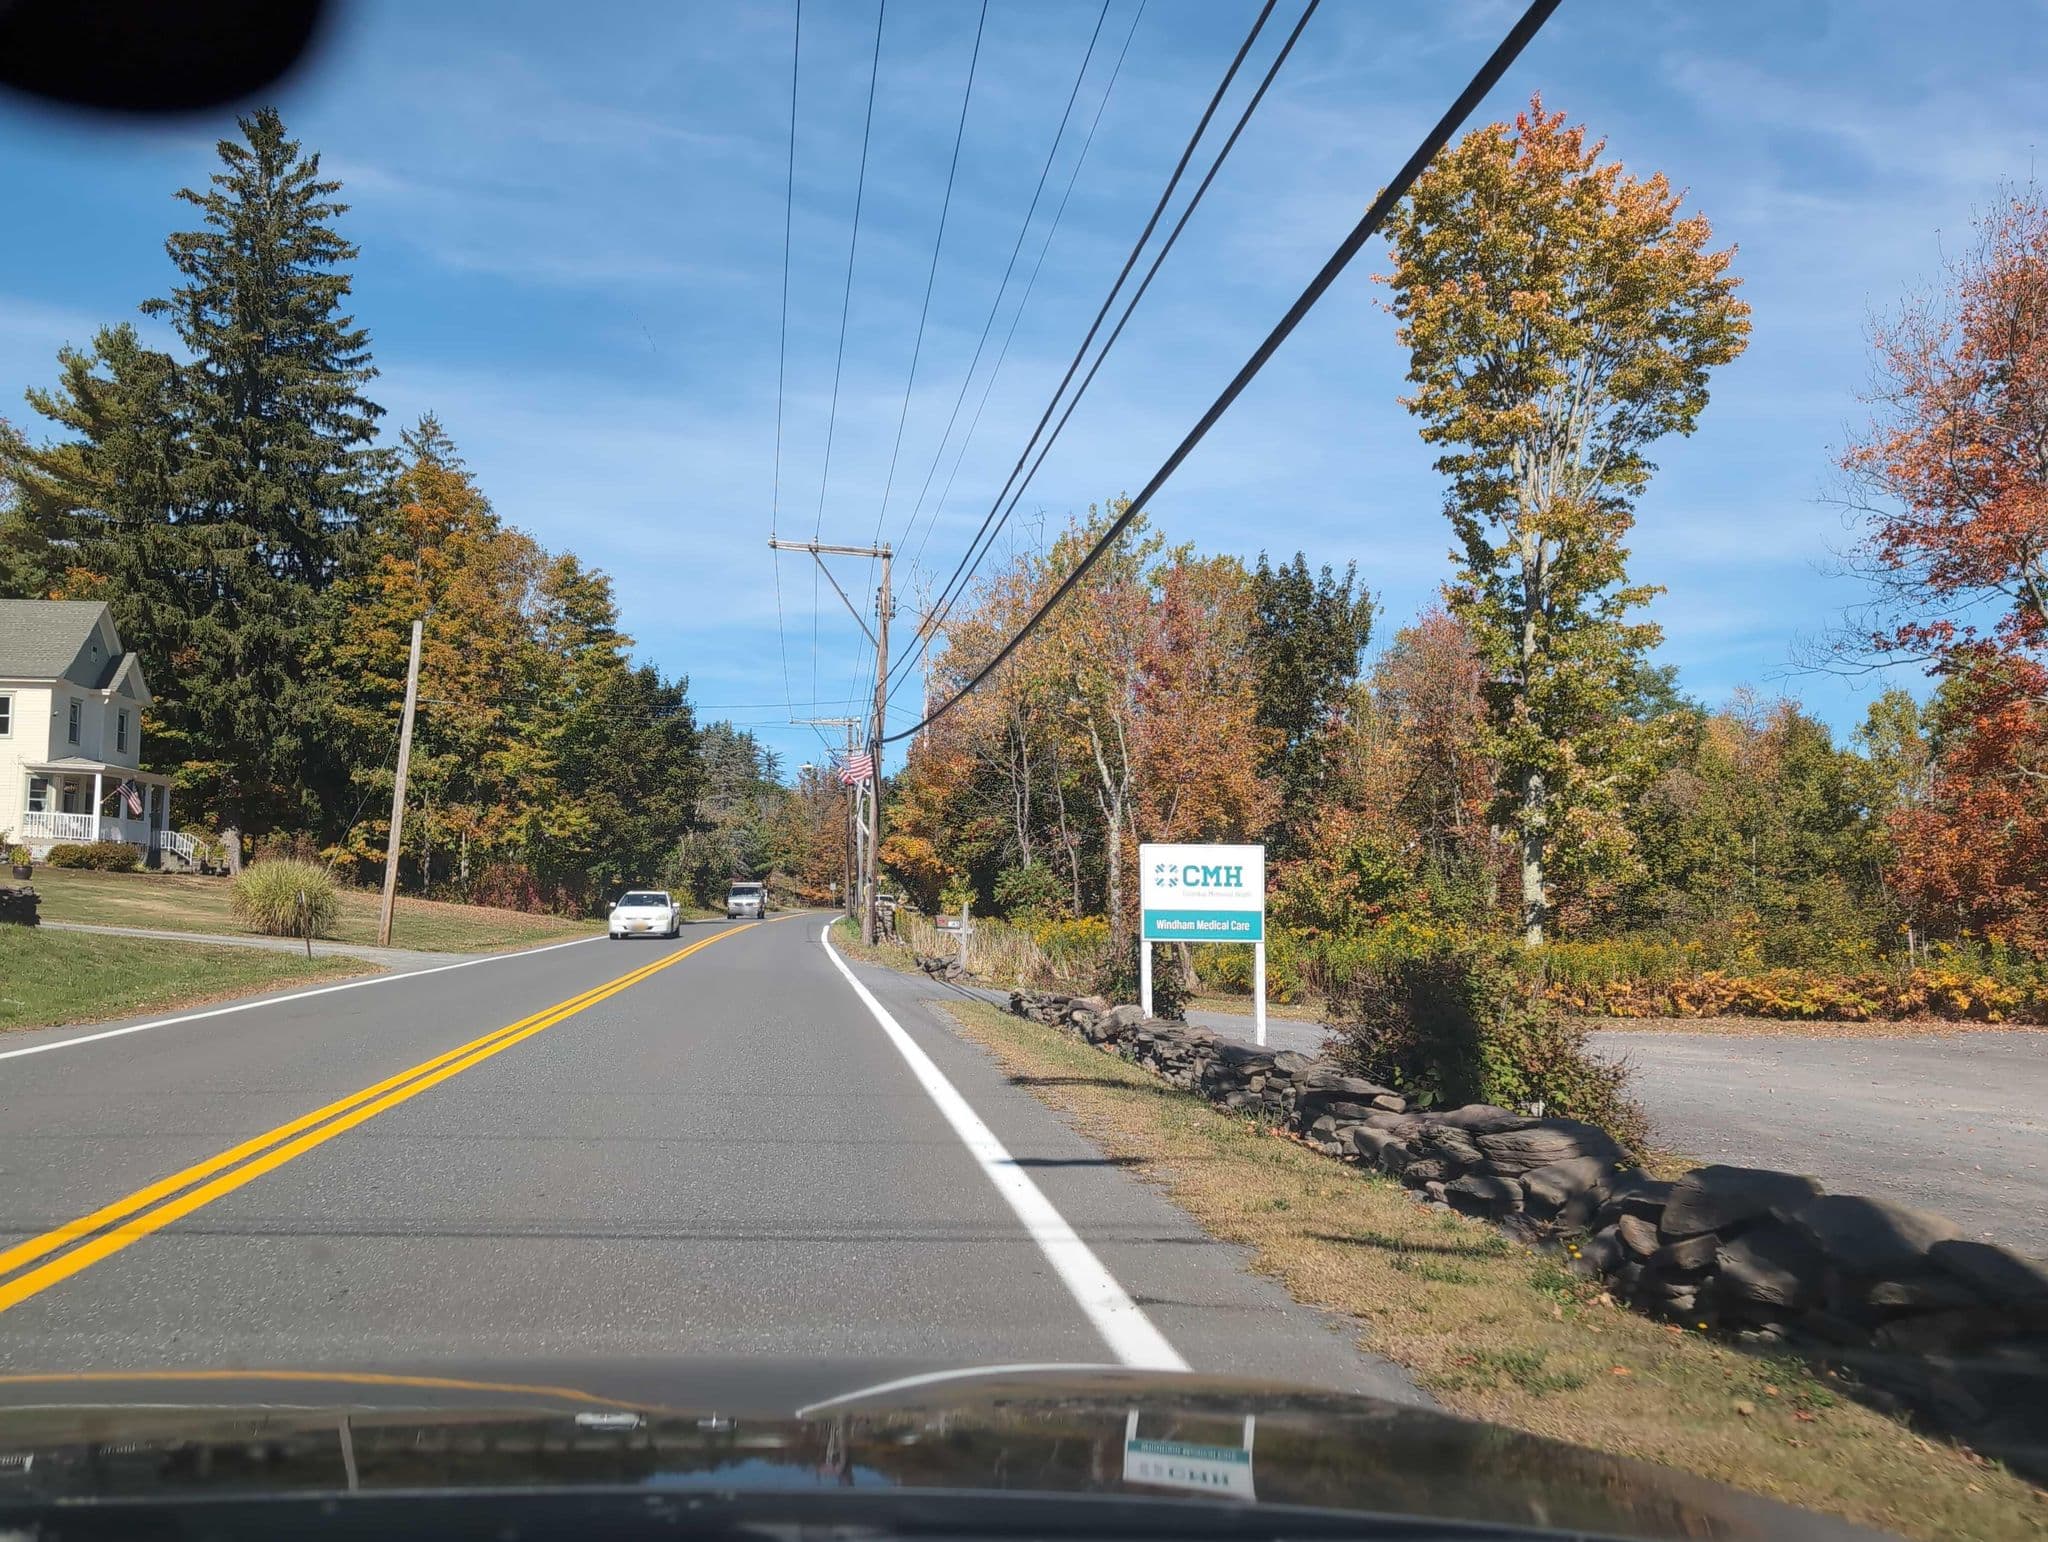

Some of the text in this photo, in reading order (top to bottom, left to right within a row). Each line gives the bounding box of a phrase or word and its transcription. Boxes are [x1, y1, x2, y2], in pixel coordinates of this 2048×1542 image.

[1183, 865, 1243, 887] CMH
[1156, 919, 1250, 931] Windham Medical Care
